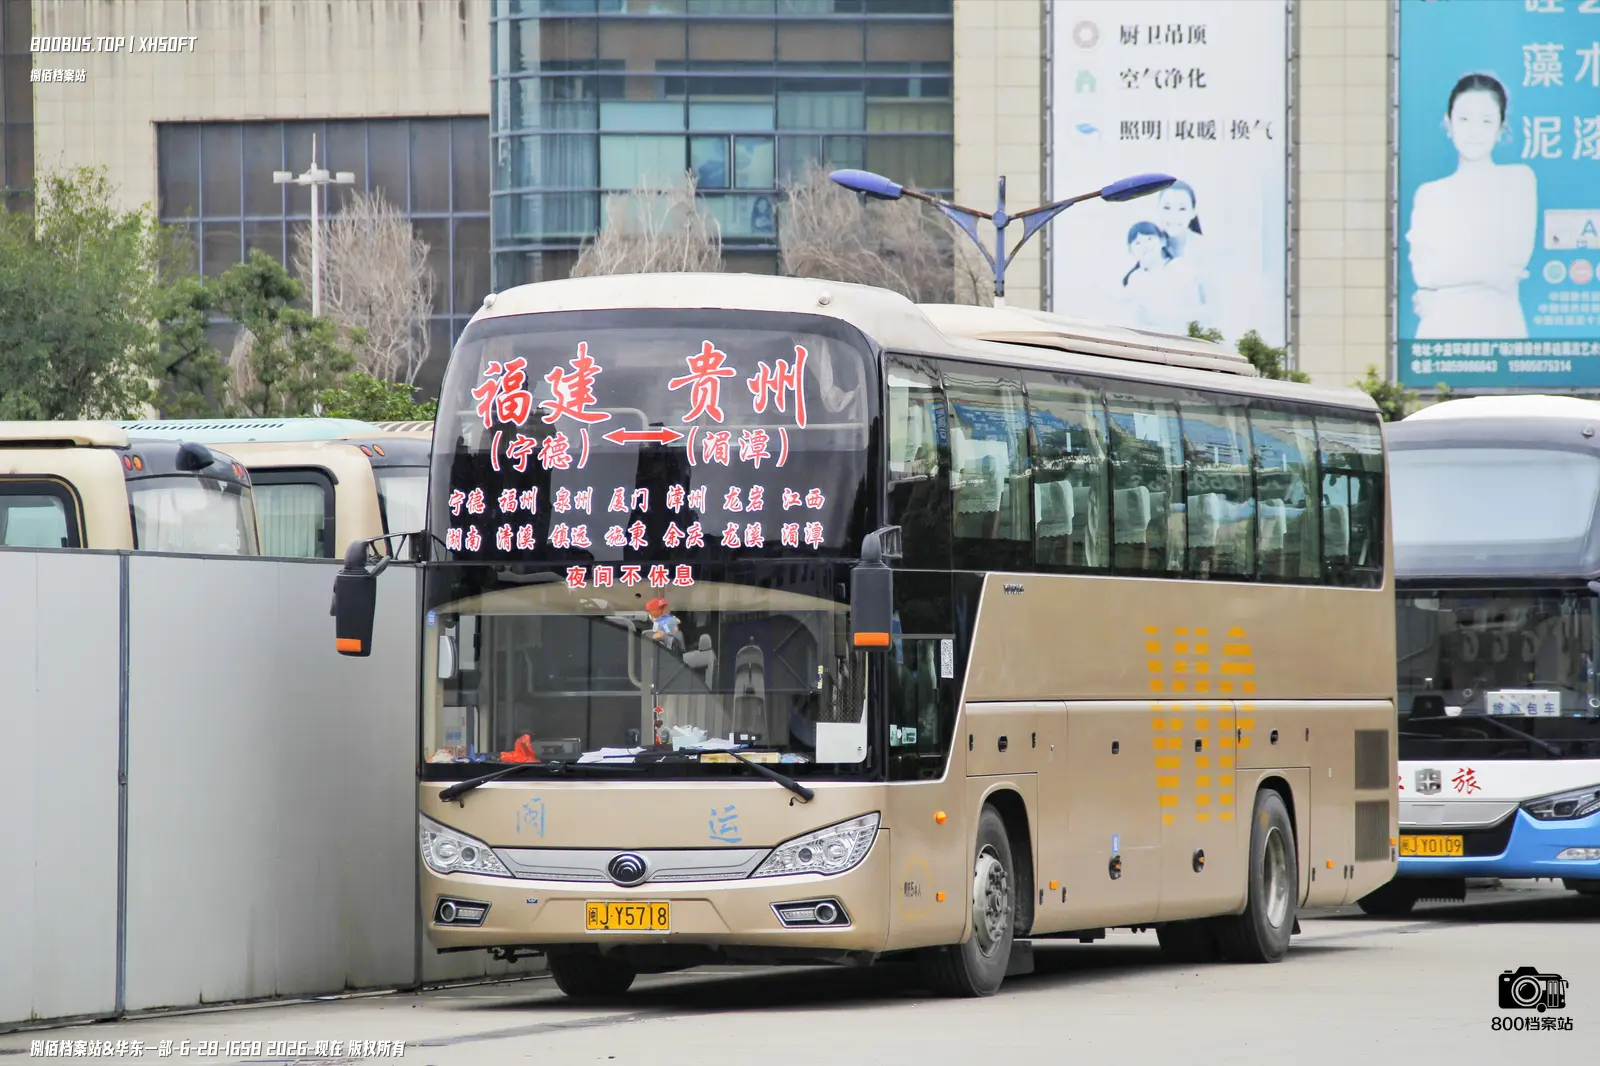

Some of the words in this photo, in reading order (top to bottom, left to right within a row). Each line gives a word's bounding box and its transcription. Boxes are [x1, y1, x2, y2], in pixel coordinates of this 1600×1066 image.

[1119, 24, 1207, 46] 厨卫吊顶
[1119, 68, 1207, 89] 空气净化
[471, 341, 612, 428] 福建
[668, 340, 808, 429] 贵州
[449, 487, 486, 516] 宁德
[498, 486, 538, 515] 福州
[553, 486, 593, 515] 泉州
[608, 486, 650, 513] 厦门
[666, 484, 707, 513] 漳州
[723, 485, 764, 512] 龙岩
[782, 487, 825, 510] 江西
[446, 525, 482, 551] 湖南
[548, 525, 592, 549] 镇远
[663, 521, 705, 548] 余庆
[721, 522, 765, 548] 龙溪
[781, 521, 824, 549] 湄潭
[566, 564, 695, 588] 夜间不休息
[1451, 767, 1482, 795] 旅
